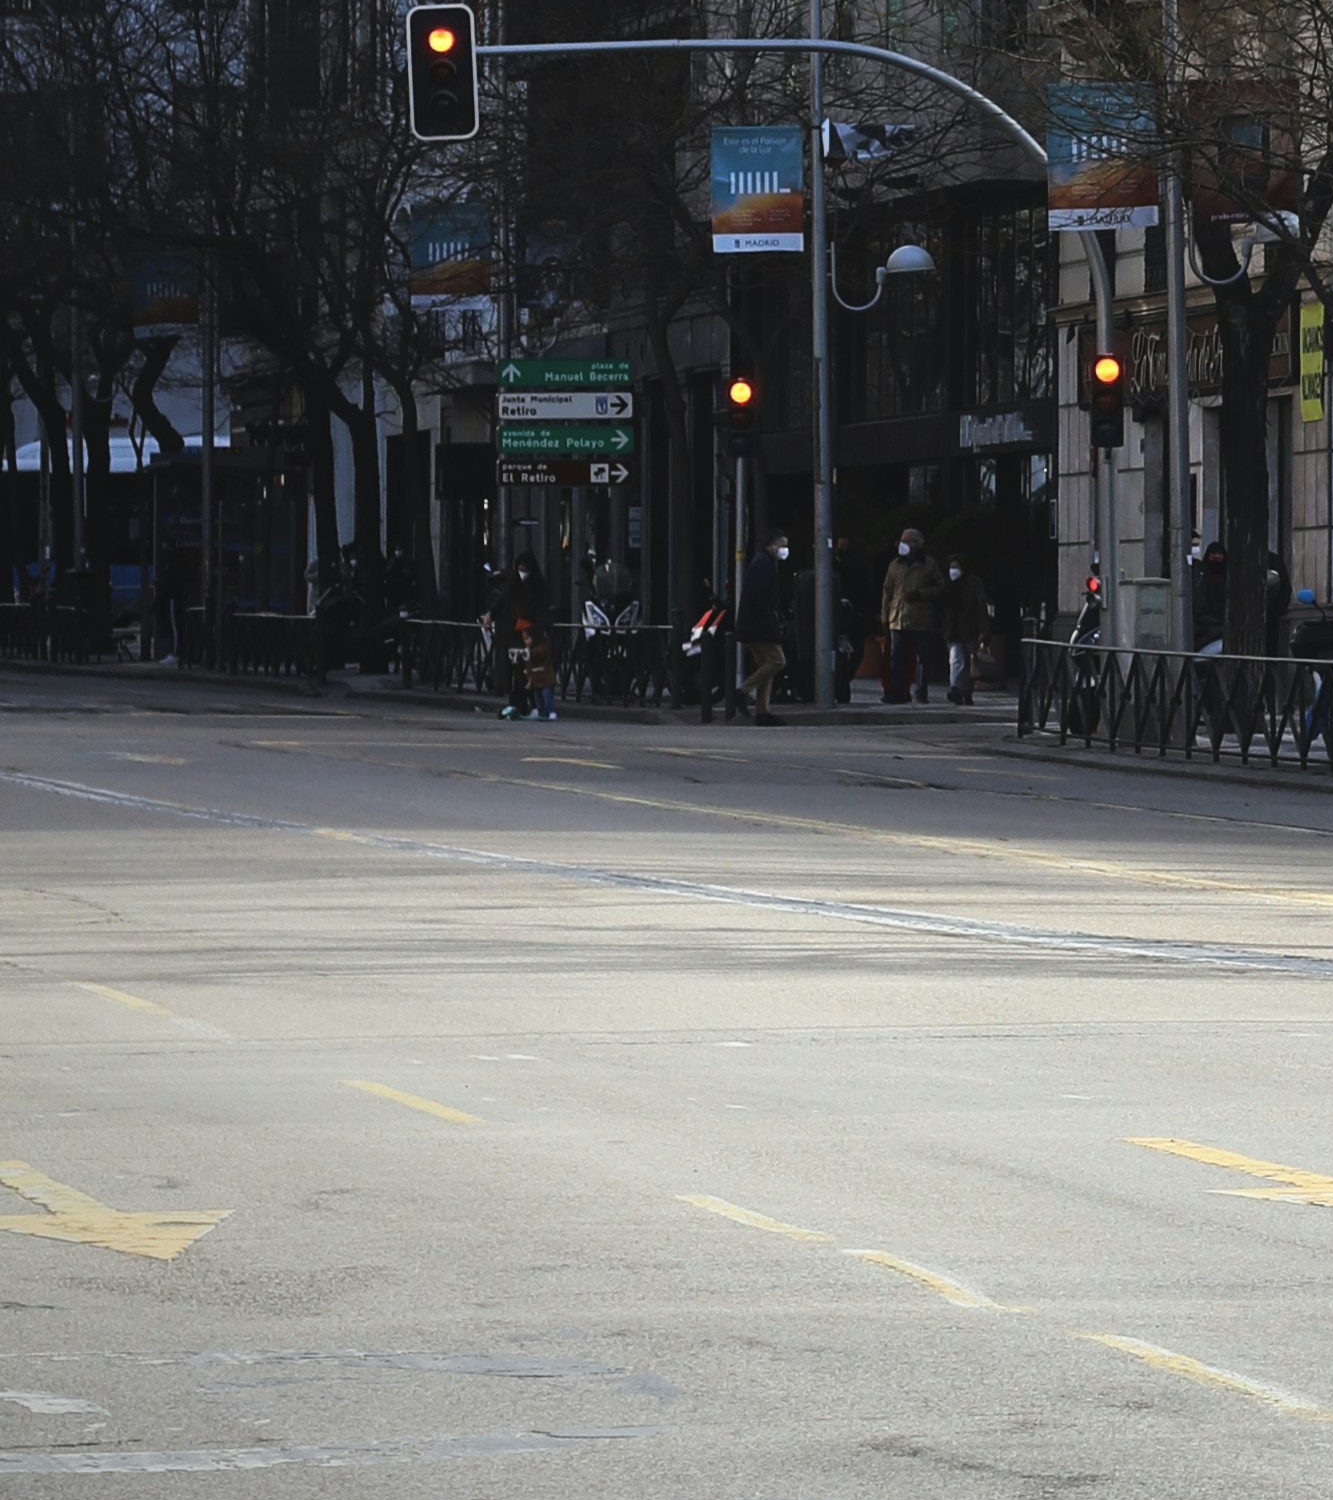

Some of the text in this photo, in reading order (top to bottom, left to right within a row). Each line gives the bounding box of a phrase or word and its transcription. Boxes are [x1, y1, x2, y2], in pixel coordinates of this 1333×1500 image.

[745, 239, 779, 248] MADRID
[591, 362, 613, 370] plaza
[544, 372, 629, 382] Manuel Becerra
[530, 395, 572, 404] Municipal
[501, 406, 537, 416] Retiro
[502, 438, 604, 449] Menéndez Pelayo
[502, 473, 556, 482] El Retiro
